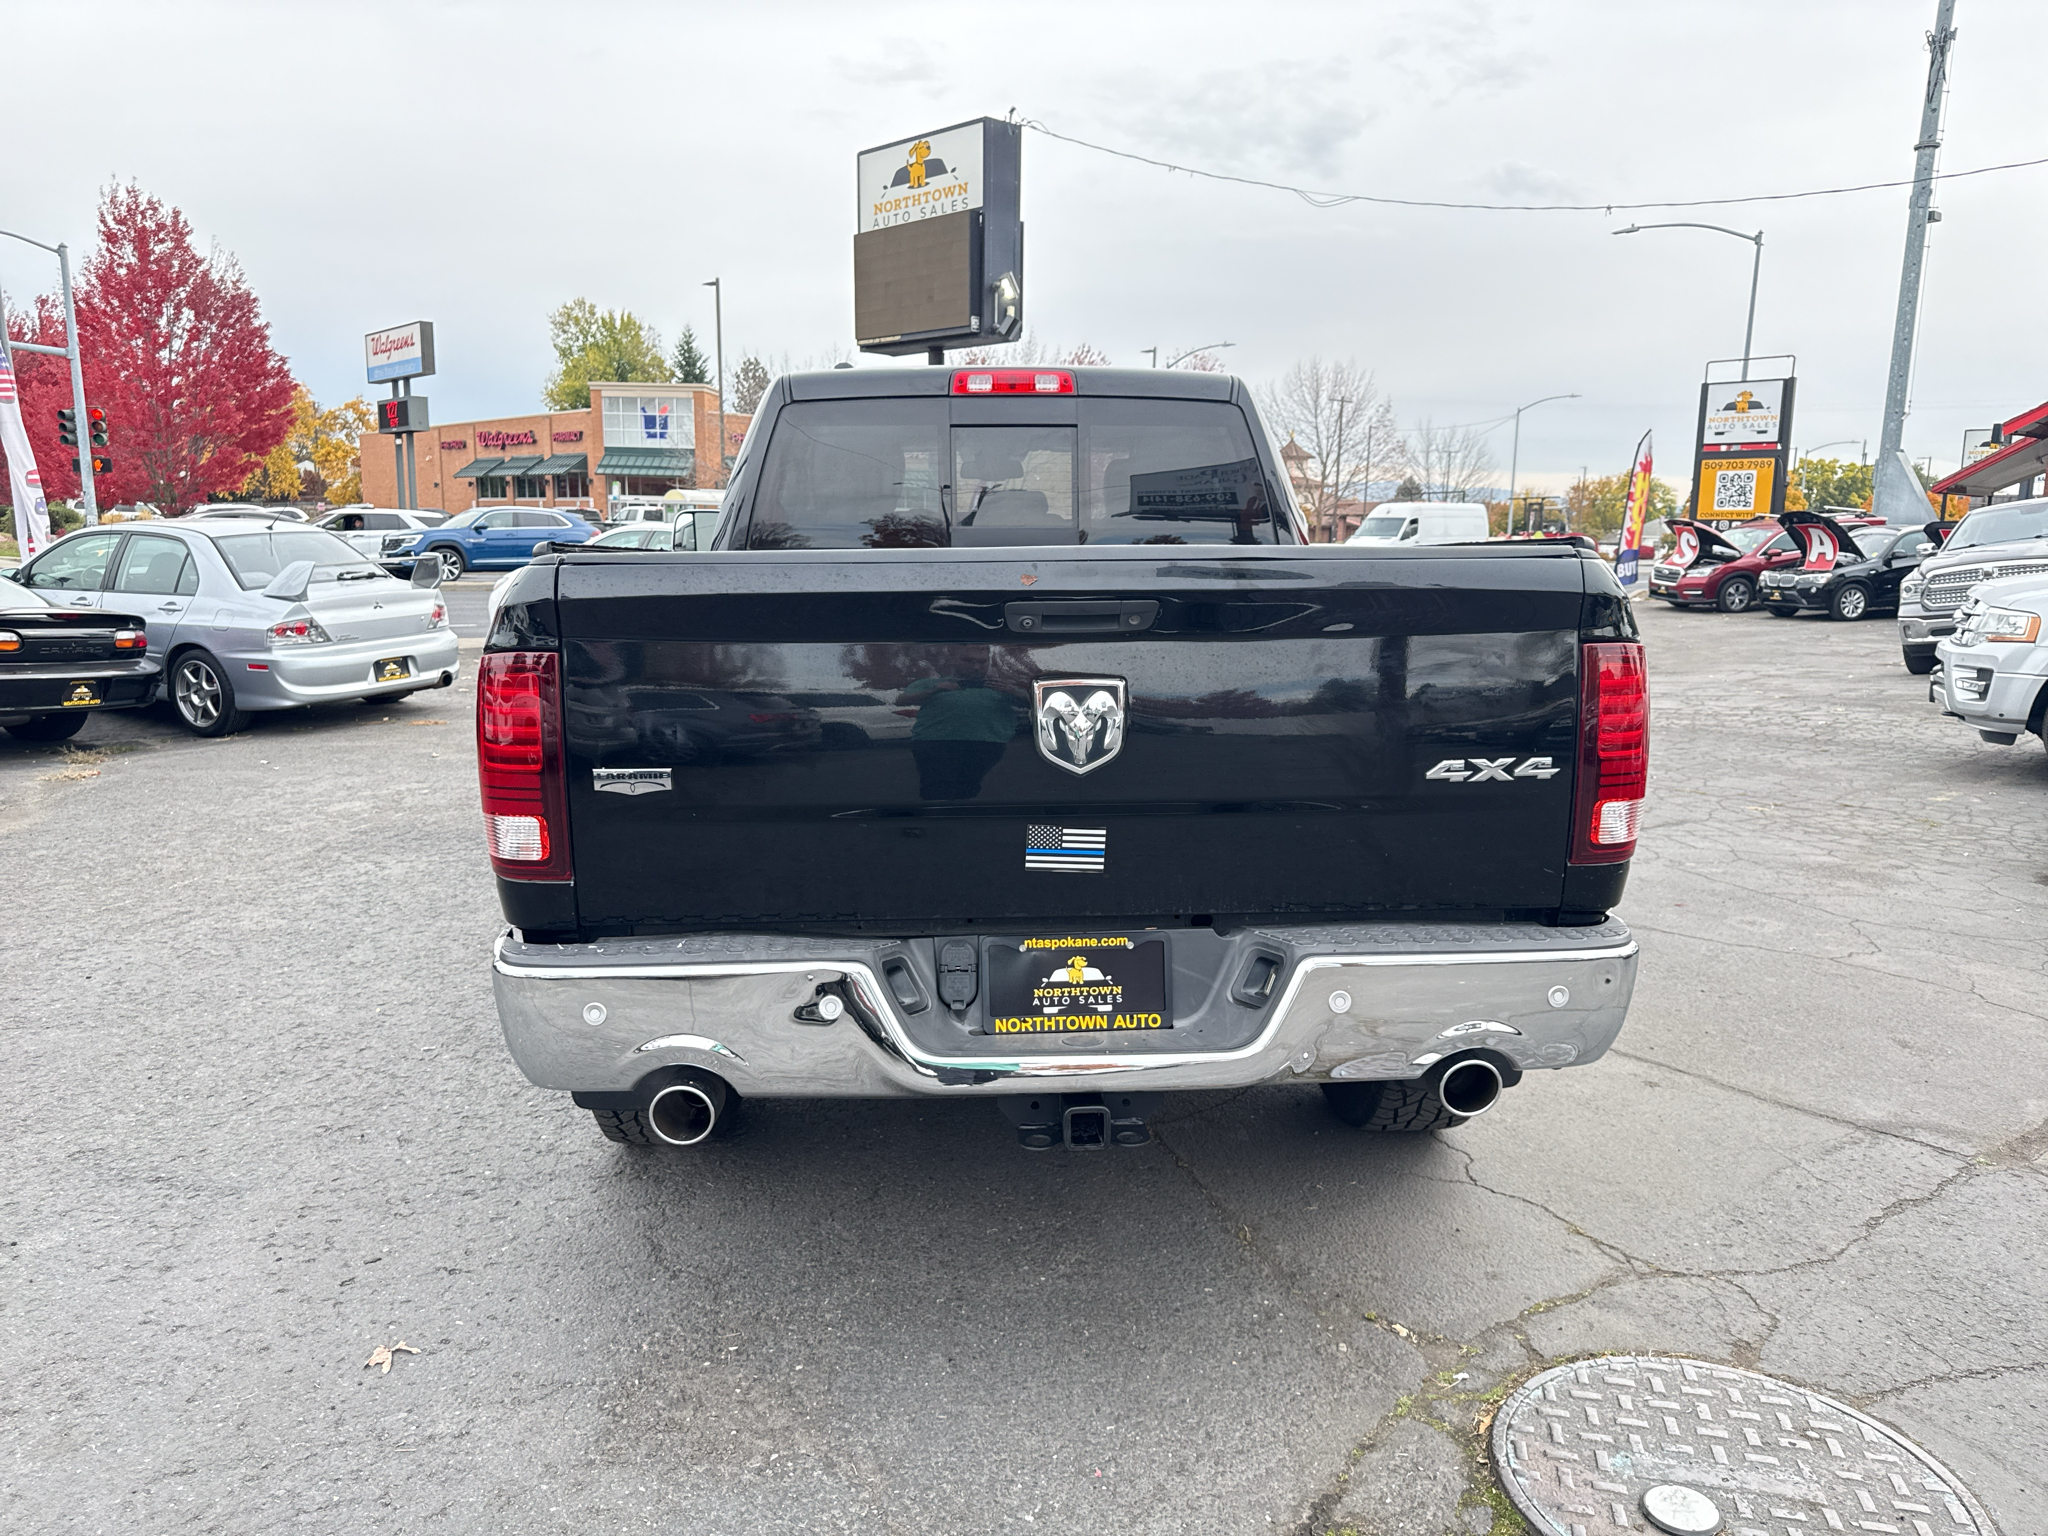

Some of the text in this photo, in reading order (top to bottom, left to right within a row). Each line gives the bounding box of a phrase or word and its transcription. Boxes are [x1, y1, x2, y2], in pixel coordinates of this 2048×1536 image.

[873, 181, 969, 216] NORTHTOWN
[873, 197, 969, 229] AUTO SALES
[371, 332, 415, 360] Walgreens
[1707, 421, 1778, 430] AUTO SALES
[1708, 414, 1779, 424] NORTHTOWN
[476, 430, 536, 451] Walgreens
[1672, 531, 1697, 565] S
[1809, 528, 1833, 563] A
[1617, 560, 1637, 578] BUY
[40, 646, 103, 654] CAMARO
[595, 771, 671, 781] LARAMIE
[1425, 756, 1561, 782] 4X4
[1024, 936, 1129, 950] ntaspokane.com
[1032, 994, 1123, 1006] AUTO SALES
[1033, 985, 1123, 997] NORTHTOWN
[995, 1013, 1162, 1033] NORTHTOWN AUTO
